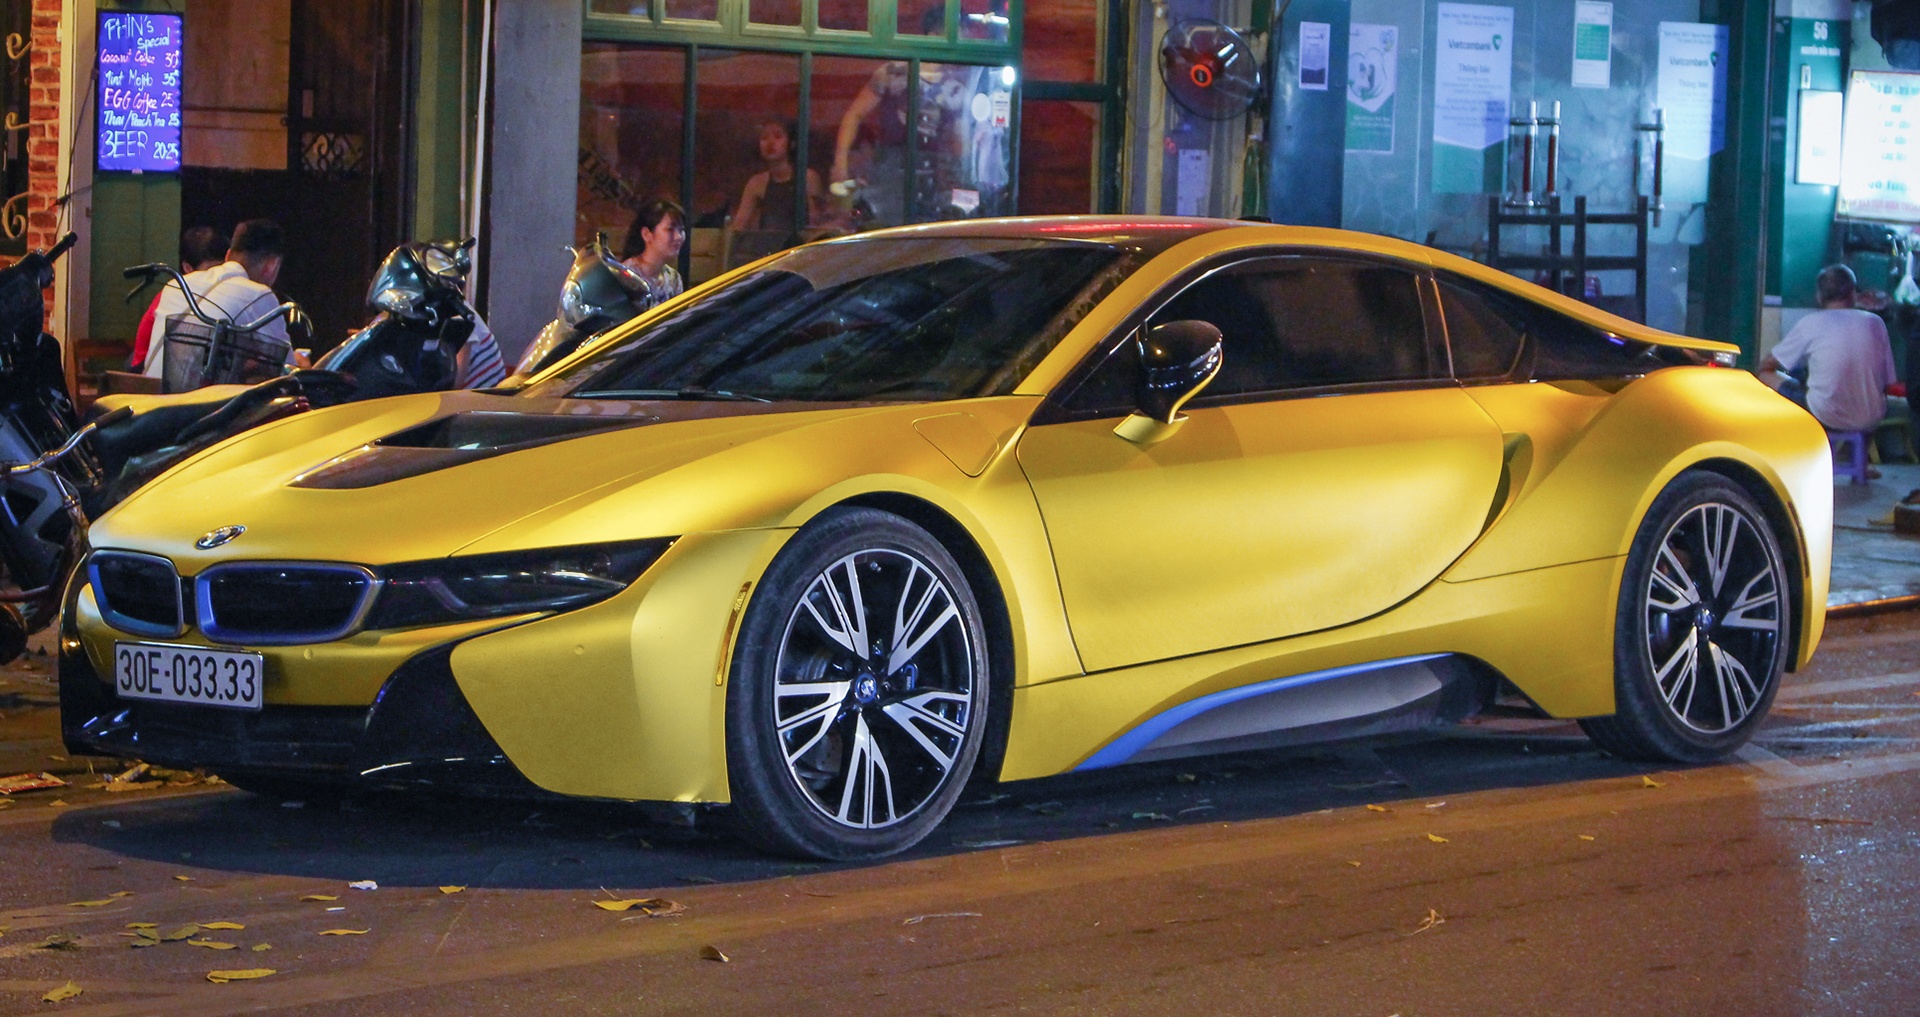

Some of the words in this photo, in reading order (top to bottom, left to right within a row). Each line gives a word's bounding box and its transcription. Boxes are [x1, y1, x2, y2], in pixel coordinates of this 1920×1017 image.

[104, 87, 132, 110] EGG
[132, 92, 158, 114] Coffee
[100, 129, 149, 159] BEER
[119, 648, 256, 702] 30E-033.33
